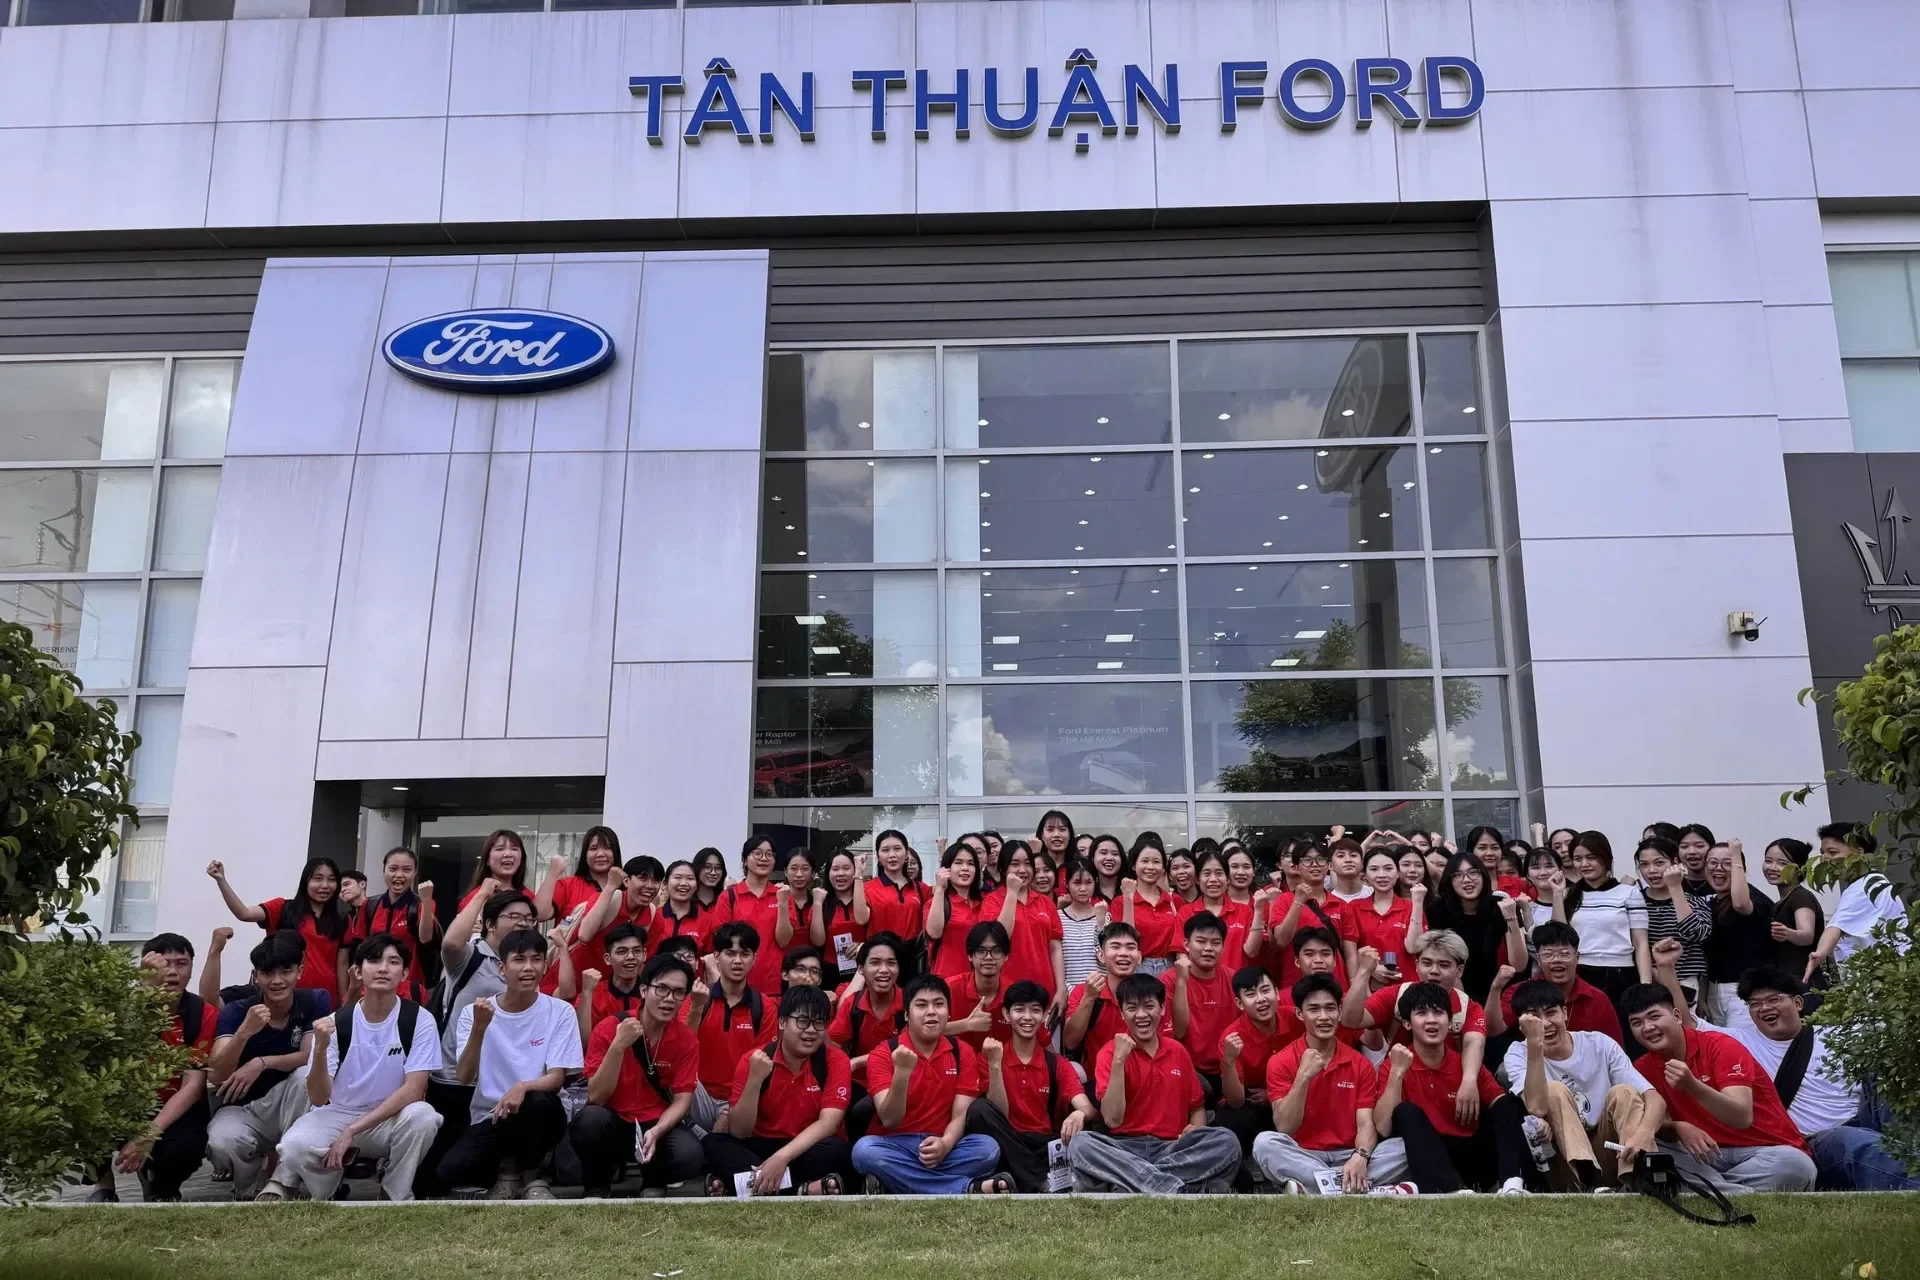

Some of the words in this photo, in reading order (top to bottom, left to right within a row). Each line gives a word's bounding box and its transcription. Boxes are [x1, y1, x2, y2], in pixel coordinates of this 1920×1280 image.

[629, 57, 816, 146] TÂN
[852, 48, 1181, 153] THUẬN
[1220, 55, 1486, 132] FORD
[422, 318, 567, 367] Ford
